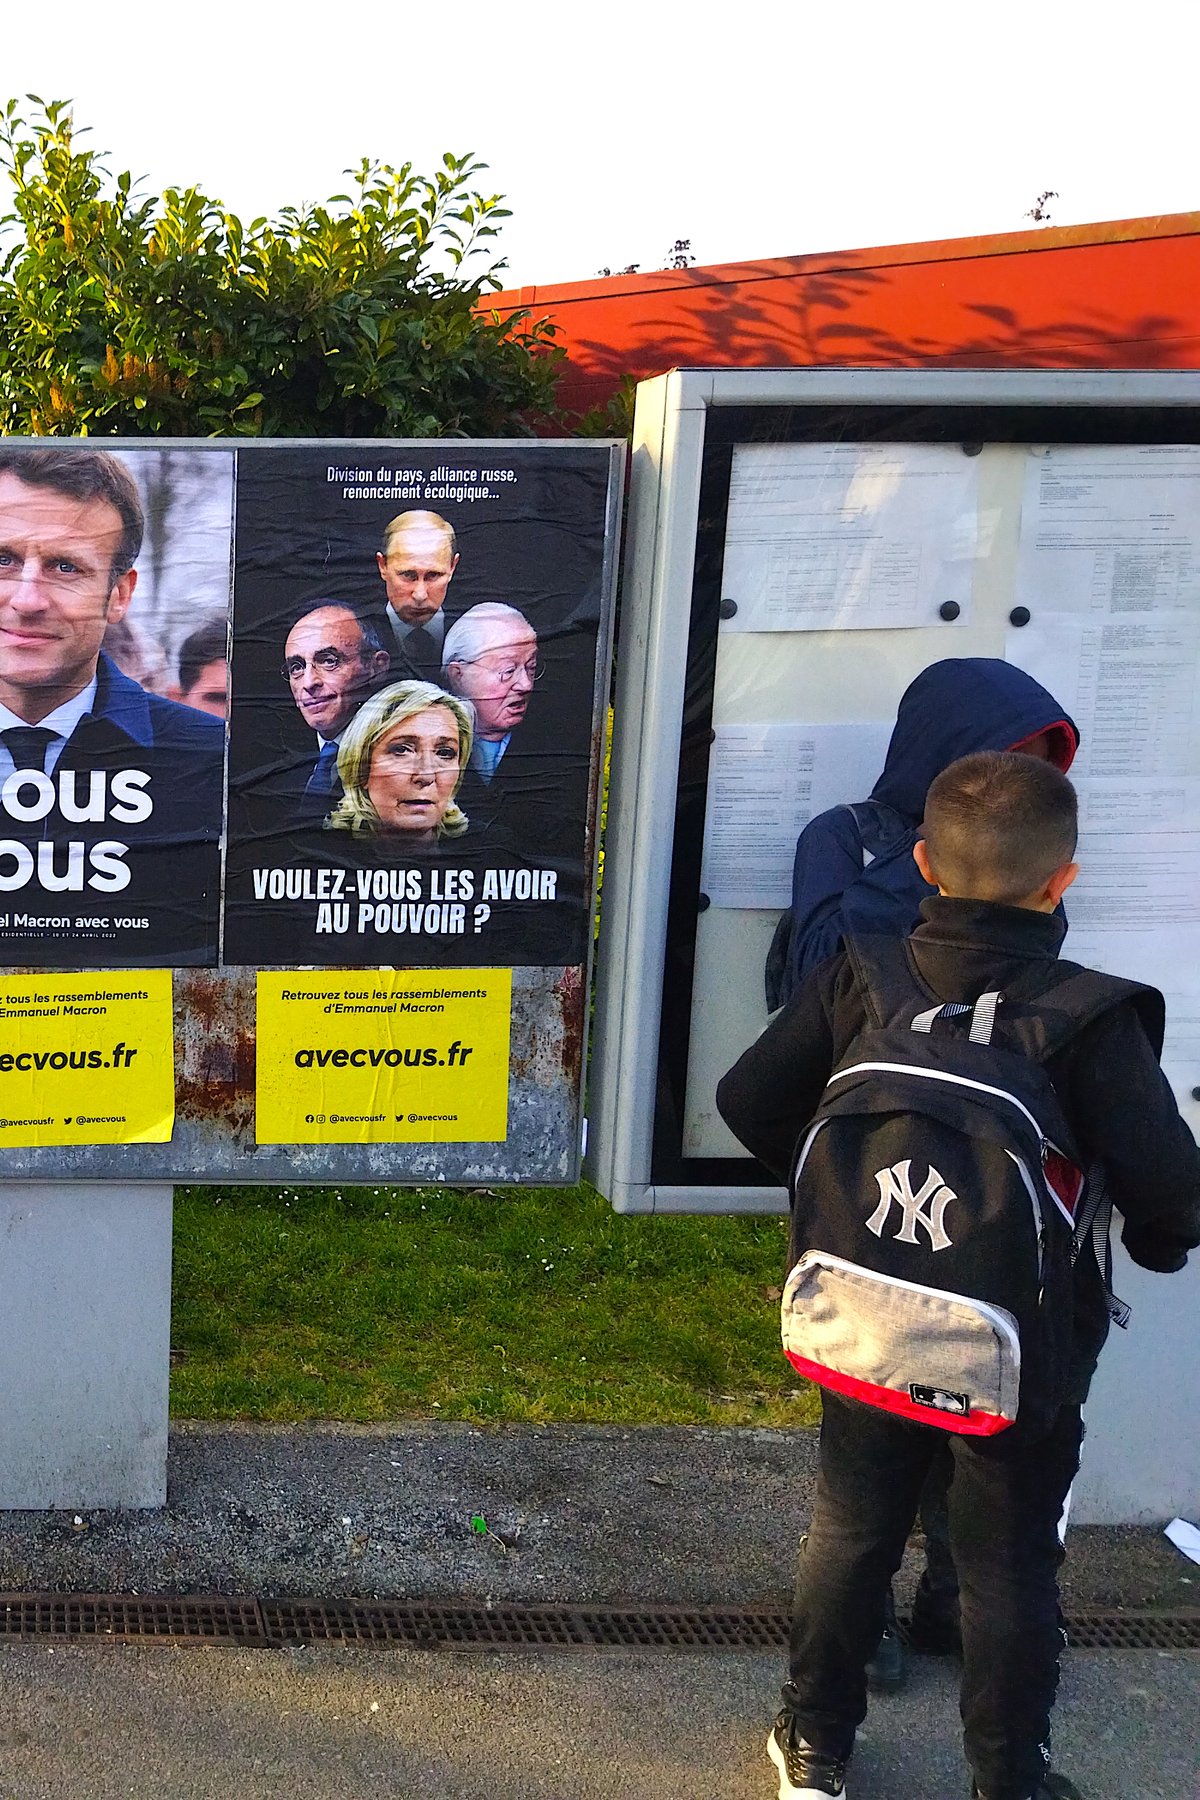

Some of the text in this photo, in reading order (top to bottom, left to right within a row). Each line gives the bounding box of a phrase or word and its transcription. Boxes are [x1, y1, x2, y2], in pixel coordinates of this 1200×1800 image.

[328, 467, 517, 486] Division du pays, alliance russe,
[344, 484, 499, 502] renoncement écologique...
[253, 869, 557, 900] VOULEZ-VOUS LES AVOIR
[14, 914, 70, 927] Macron
[75, 917, 109, 928] avec
[114, 918, 149, 928] vous
[316, 903, 490, 933] AU POUVOIR ?
[34, 994, 49, 1002] les
[53, 991, 148, 1002] rassemblements
[282, 989, 486, 1000] Retrouvez tous les rassemblements
[63, 1006, 106, 1015] Macron
[400, 1003, 444, 1012] Macron
[295, 1041, 473, 1067] avecvous.fr
[76, 1116, 126, 1125] @avecvous
[330, 1114, 457, 1123] @avecvousfr @avecvous
[866, 1159, 958, 1252] NY
